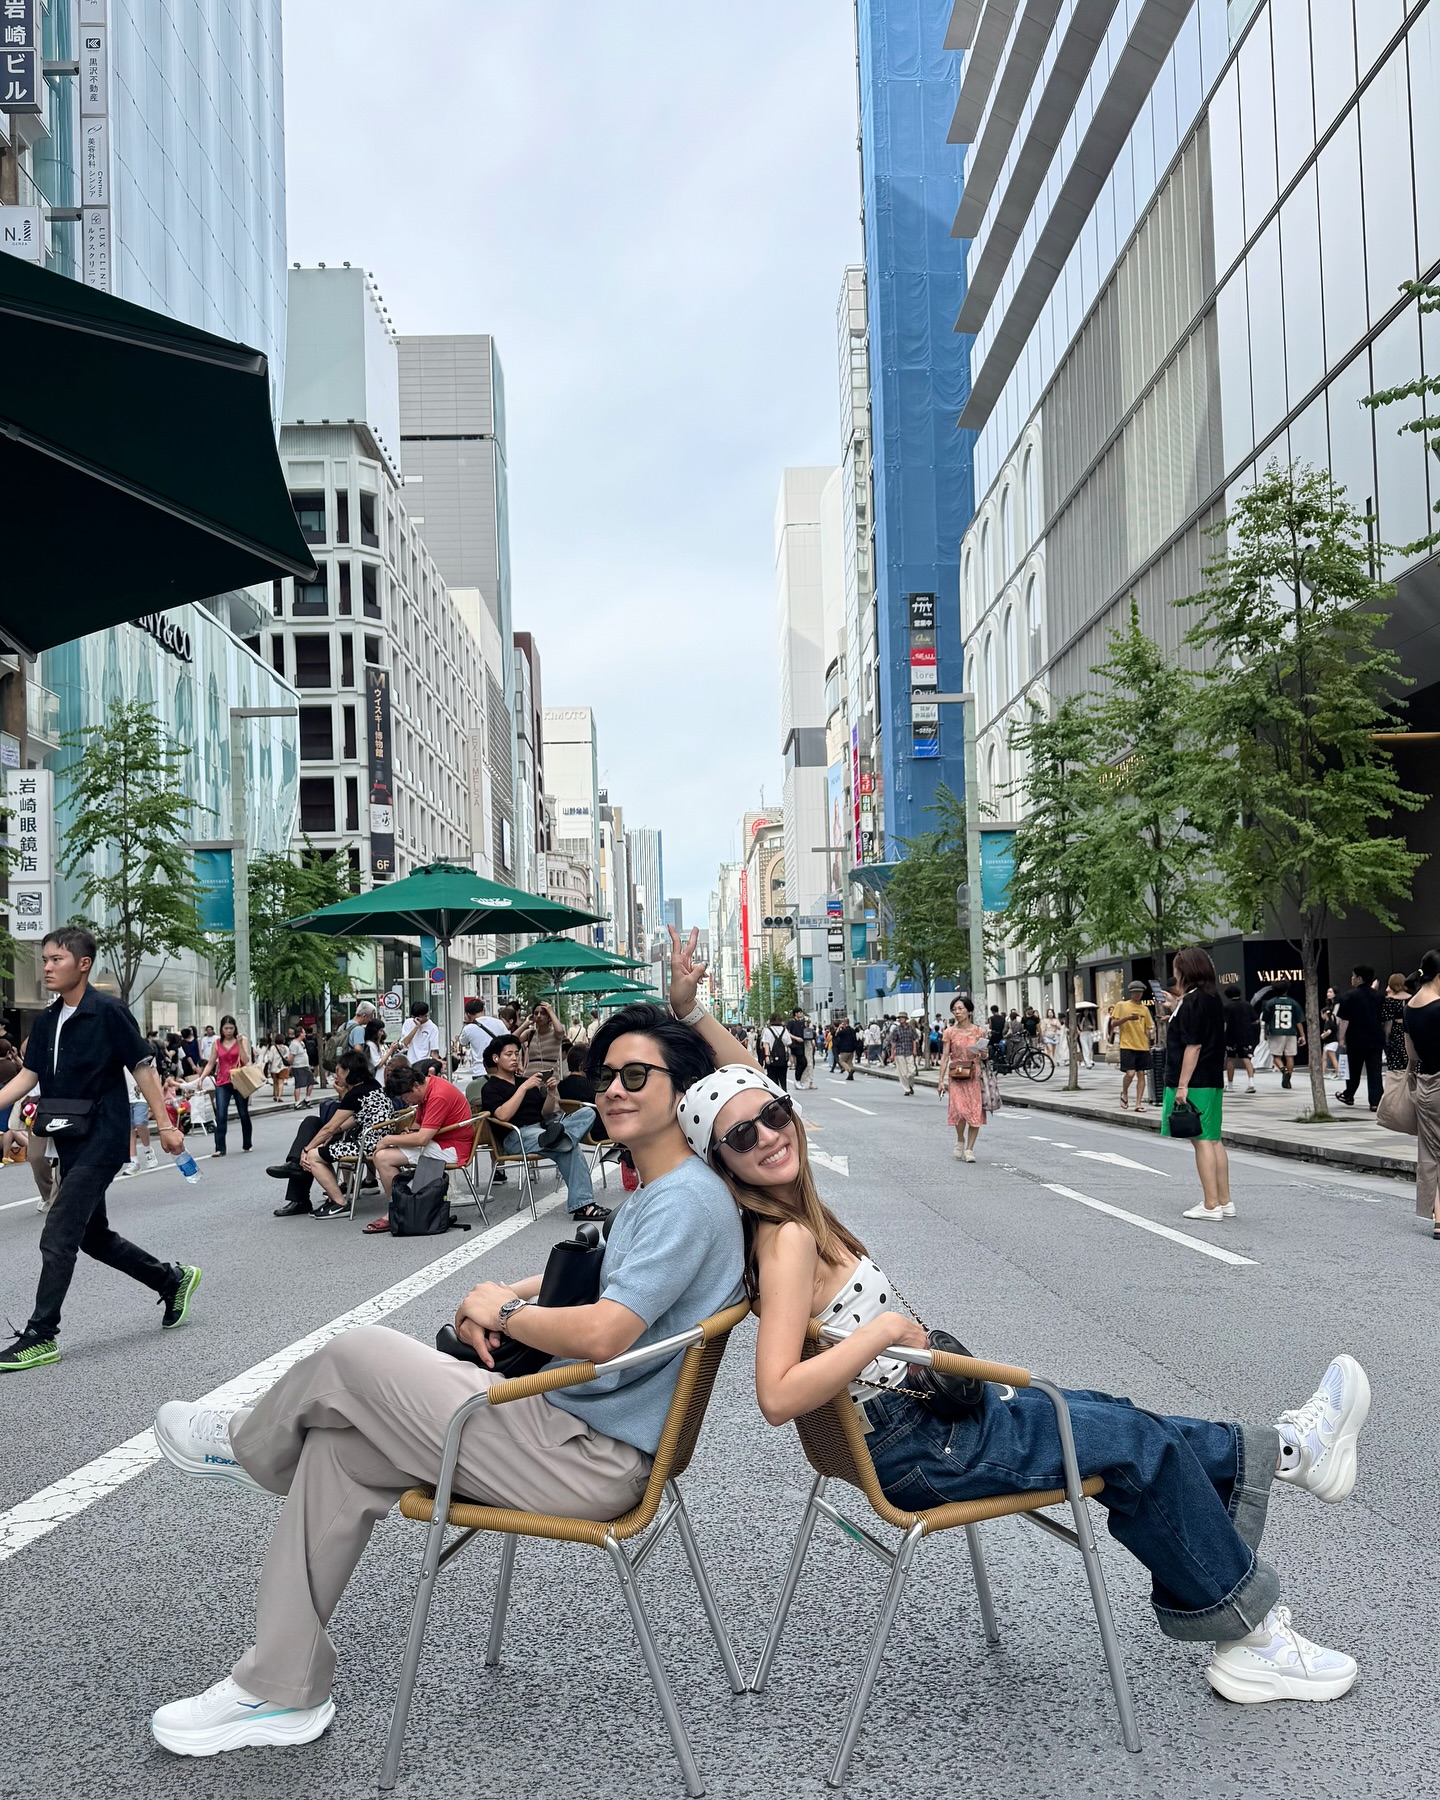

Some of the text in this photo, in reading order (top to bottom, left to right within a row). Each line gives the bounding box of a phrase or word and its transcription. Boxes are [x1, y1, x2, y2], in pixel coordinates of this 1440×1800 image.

[4, 0, 27, 100] 岩崎ビル
[89, 58, 98, 101] 黒沢不動産
[370, 671, 385, 688] M
[374, 689, 383, 758] ウイスキー博物館
[544, 711, 587, 720] KIMOTO
[19, 778, 37, 872] 岩崎眼鏡店
[376, 860, 390, 870] 6F
[1257, 969, 1305, 982] VALENTI
[1275, 1010, 1292, 1029] 19
[51, 1118, 69, 1126] NIKE
